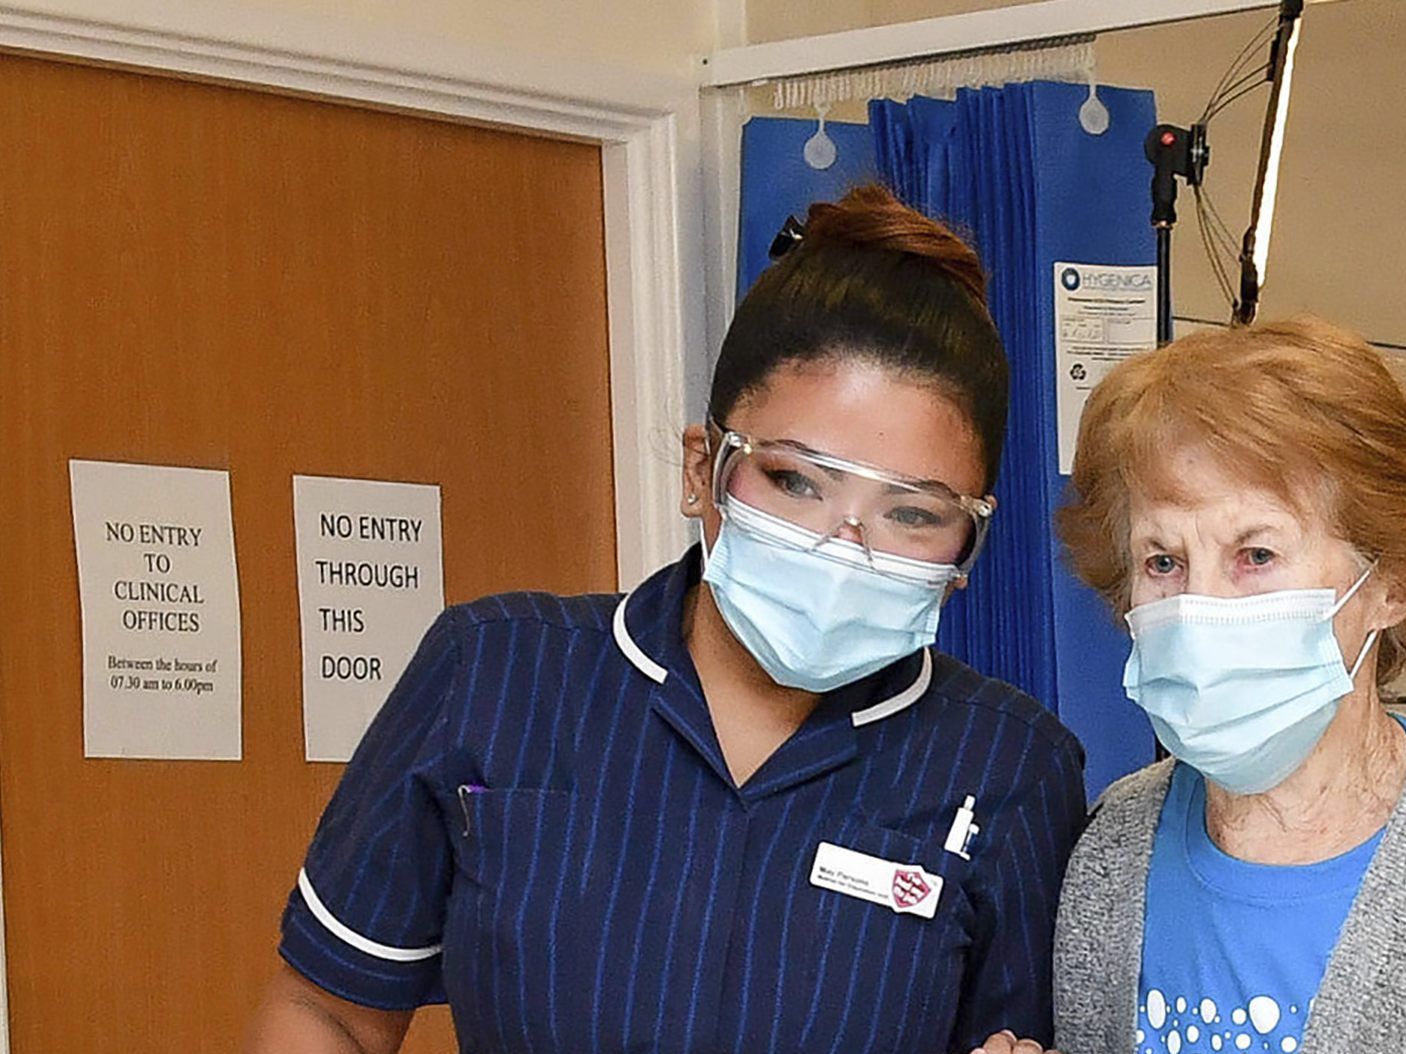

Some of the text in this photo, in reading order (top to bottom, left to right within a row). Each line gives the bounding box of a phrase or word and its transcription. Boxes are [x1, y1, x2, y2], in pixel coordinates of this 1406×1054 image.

[106, 522, 202, 546] NO ENTRY
[321, 514, 422, 542] NO ENTRY
[144, 553, 170, 573] TO
[315, 561, 418, 589] THROUGH
[114, 581, 204, 604] CLINICAL
[123, 610, 200, 632] OFFICES
[319, 608, 364, 632] THIS
[108, 656, 217, 673] Between the hours of
[321, 656, 381, 680] DOOR
[110, 676, 213, 695] 07.30 am to 6.00pm
